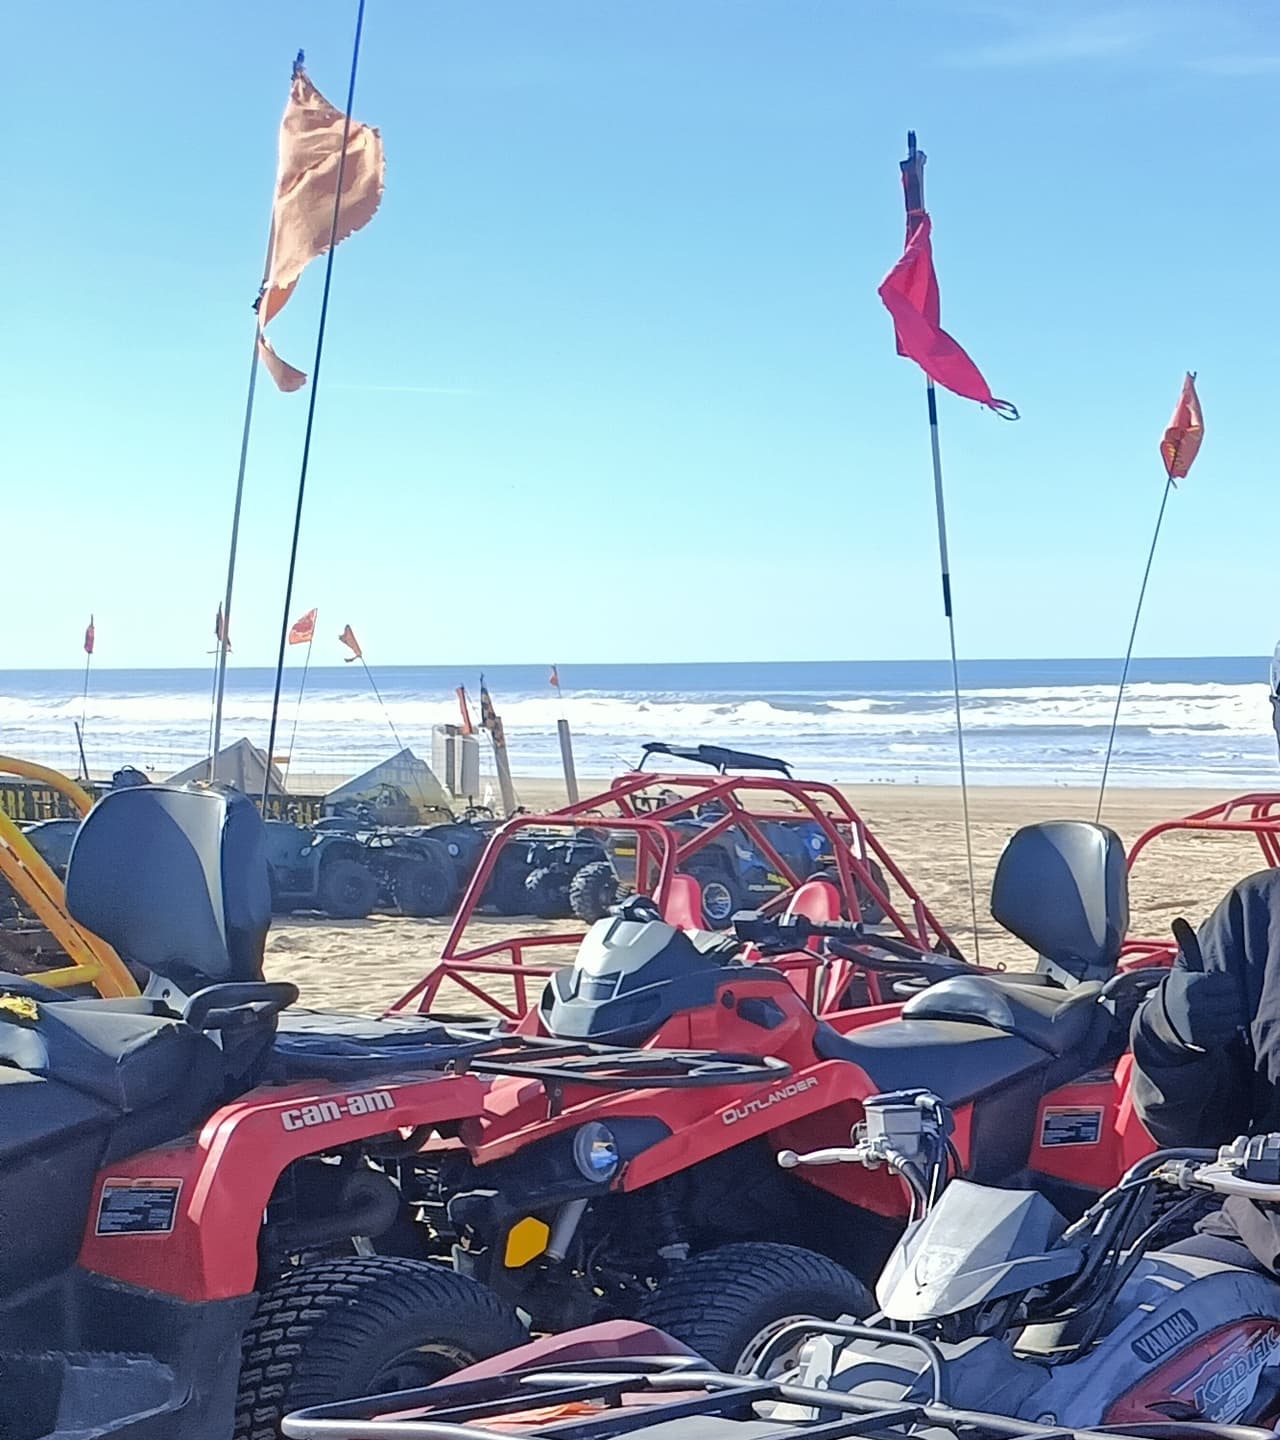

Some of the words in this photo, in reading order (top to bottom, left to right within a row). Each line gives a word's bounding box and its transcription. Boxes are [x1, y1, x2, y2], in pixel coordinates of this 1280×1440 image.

[720, 1076, 819, 1126] OUTLANDER
[1134, 1311, 1196, 1361] YAMAHA
[1194, 1327, 1280, 1414] KODIAK
